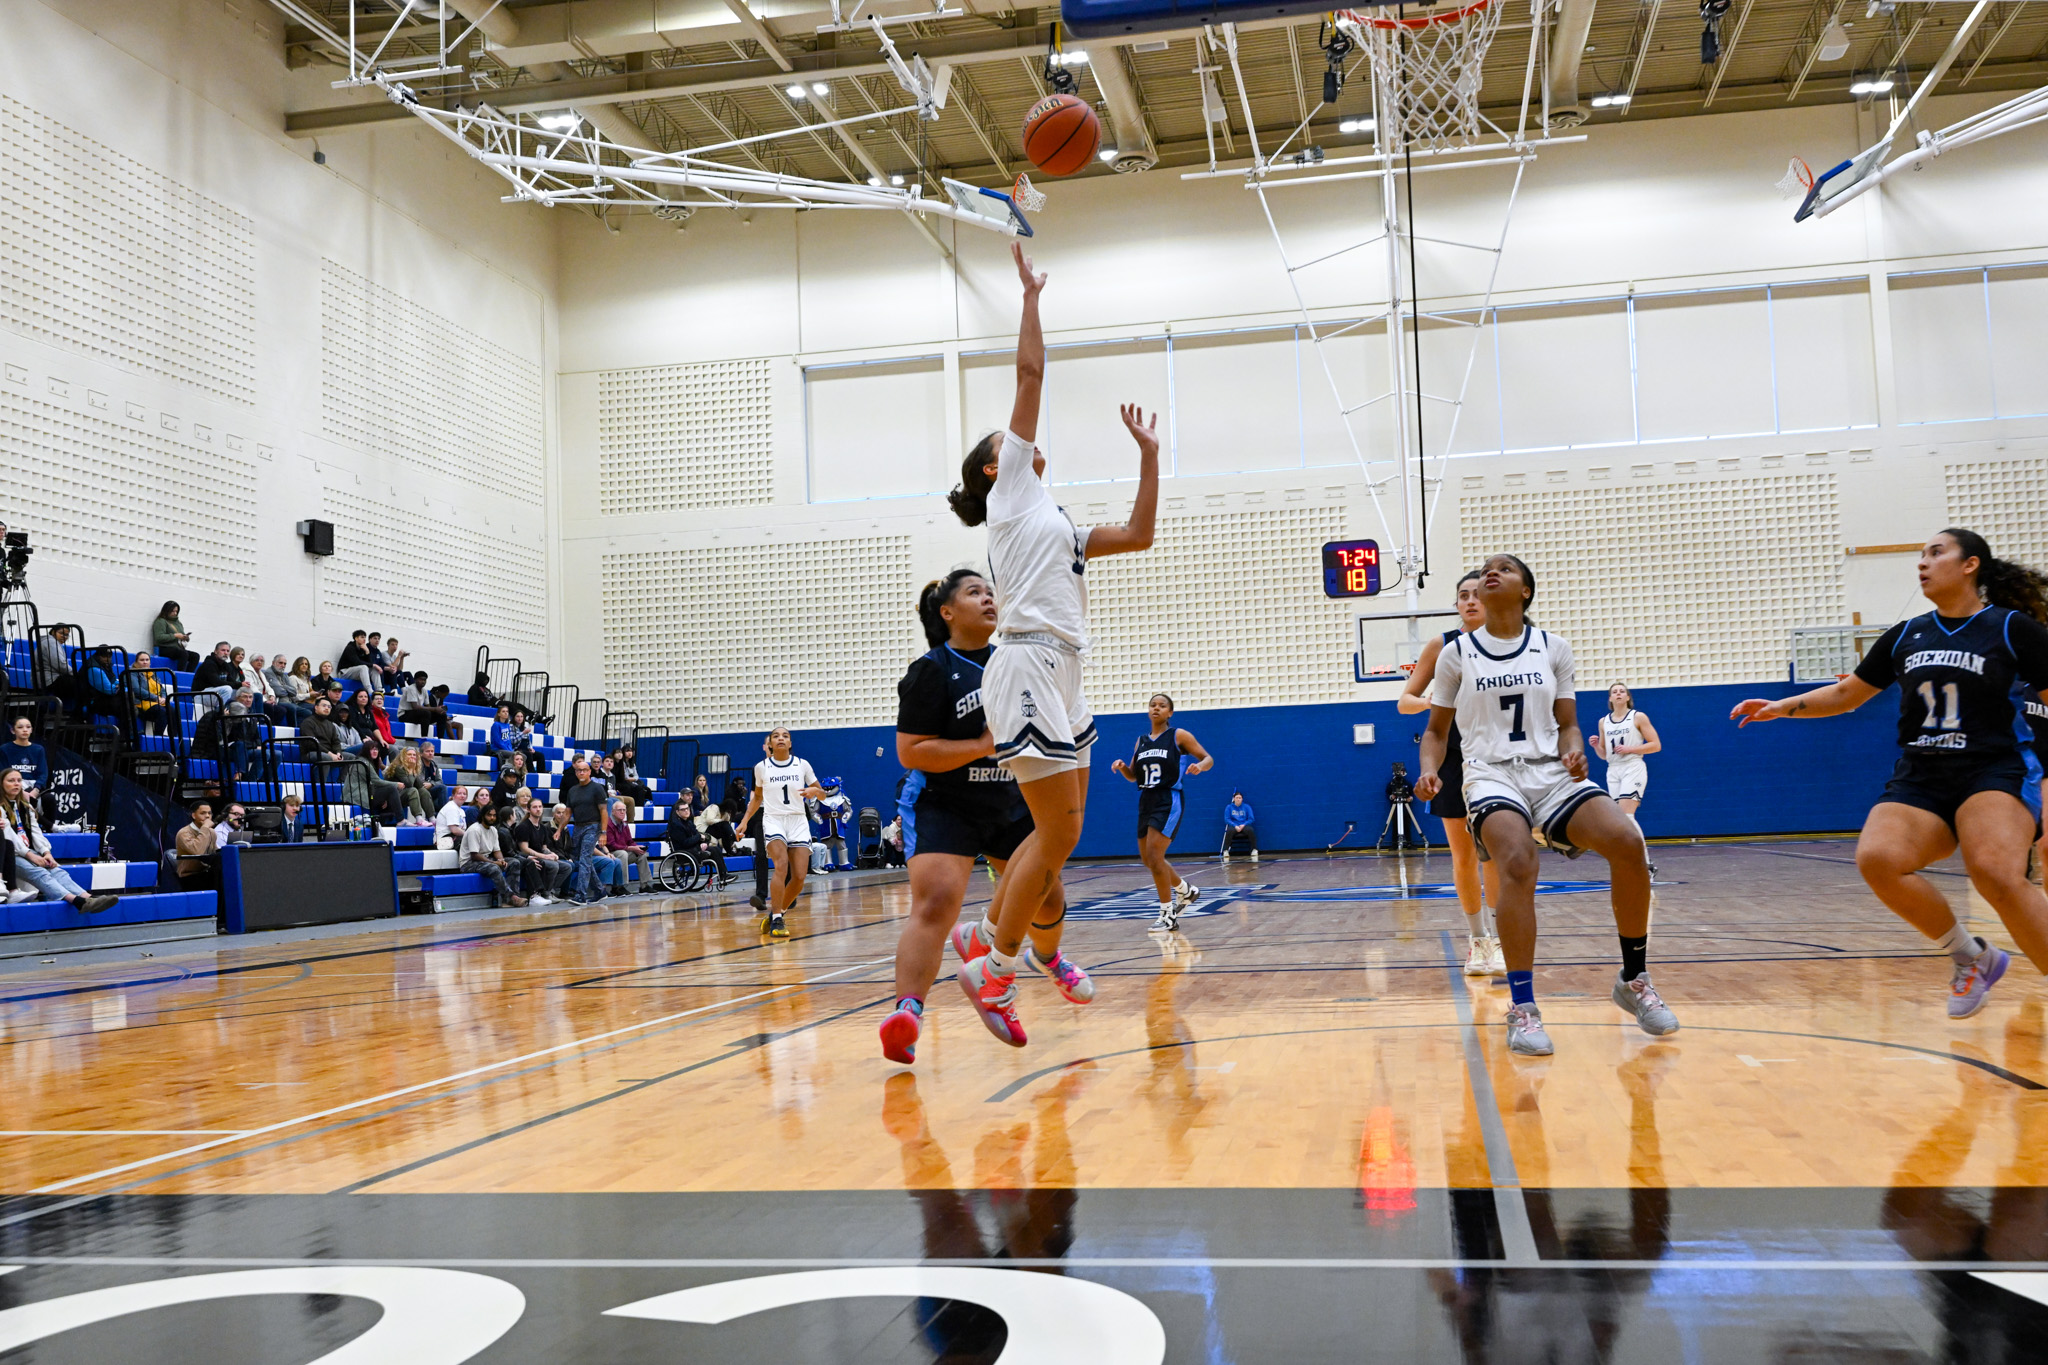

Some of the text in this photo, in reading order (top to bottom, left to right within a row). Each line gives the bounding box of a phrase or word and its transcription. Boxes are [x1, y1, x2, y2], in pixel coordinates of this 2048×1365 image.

[1338, 549, 1377, 567] 7:24
[1346, 568, 1367, 592] 18
[1904, 650, 1985, 675] SHERIDAN
[1476, 672, 1543, 691] KNIGHTS
[1917, 681, 1961, 729] 11
[1499, 693, 1527, 742] 7
[1137, 748, 1168, 761] SHERIDAN
[769, 774, 799, 783] KNIGHTS
[1143, 763, 1162, 785] 12
[782, 784, 790, 805] 1
